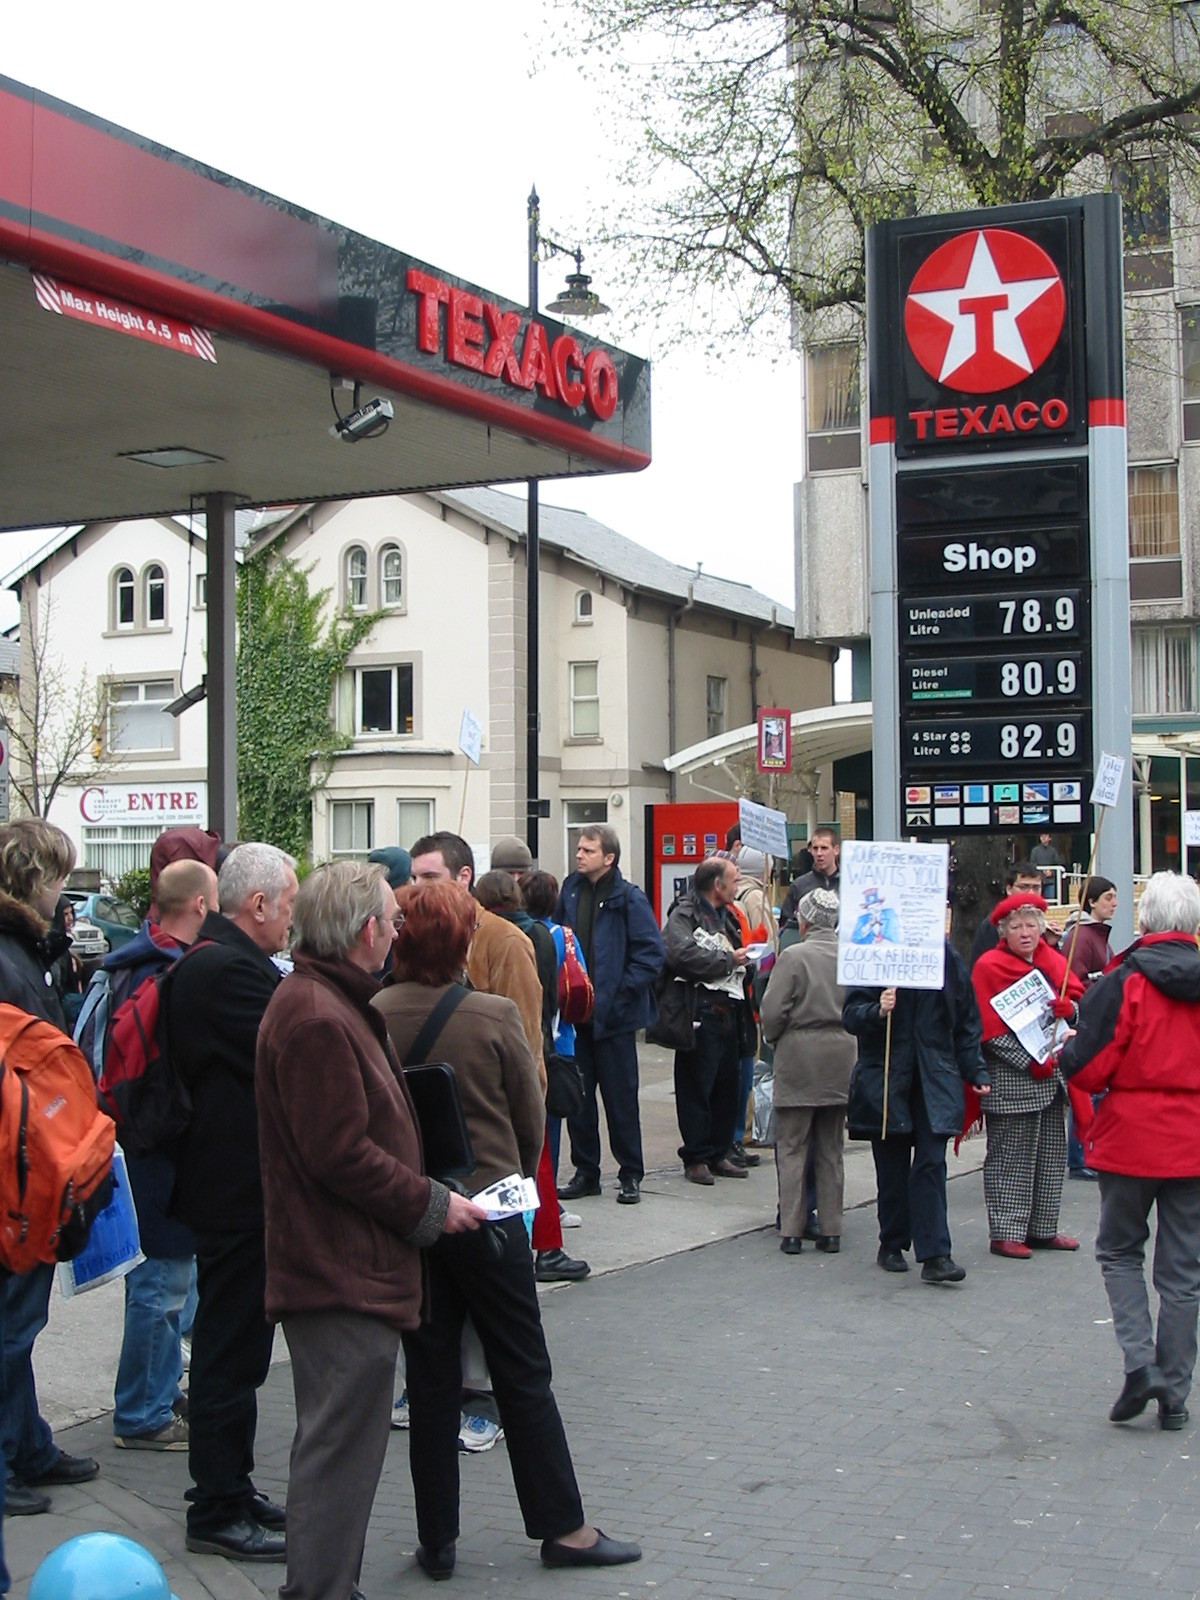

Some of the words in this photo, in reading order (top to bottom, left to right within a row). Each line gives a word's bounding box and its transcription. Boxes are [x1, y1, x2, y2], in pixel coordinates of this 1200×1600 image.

[60, 290, 93, 314] Max
[95, 302, 145, 330] Height
[147, 319, 172, 339] 4.5
[178, 331, 193, 346] m
[407, 269, 619, 421] TEXACO
[908, 398, 1069, 439] TEXACO
[943, 543, 1036, 573] Shop
[910, 606, 970, 620] Unleaded
[999, 596, 1075, 634] 78.9
[910, 624, 940, 635] Litre
[912, 668, 948, 678] Diesel
[1001, 659, 1077, 696] 80.9
[912, 681, 939, 690] Litre
[912, 732, 919, 742] 4
[922, 731, 947, 742] Star
[1000, 722, 1077, 758] 82.9
[913, 746, 940, 756] Litre
[846, 863, 906, 887] WANTS
[912, 866, 939, 887] YOU
[844, 948, 881, 962] LOOK
[885, 949, 919, 963] AFTER
[920, 949, 939, 964] HIS
[843, 963, 869, 980] OIL
[872, 963, 938, 981] INTERESTS
